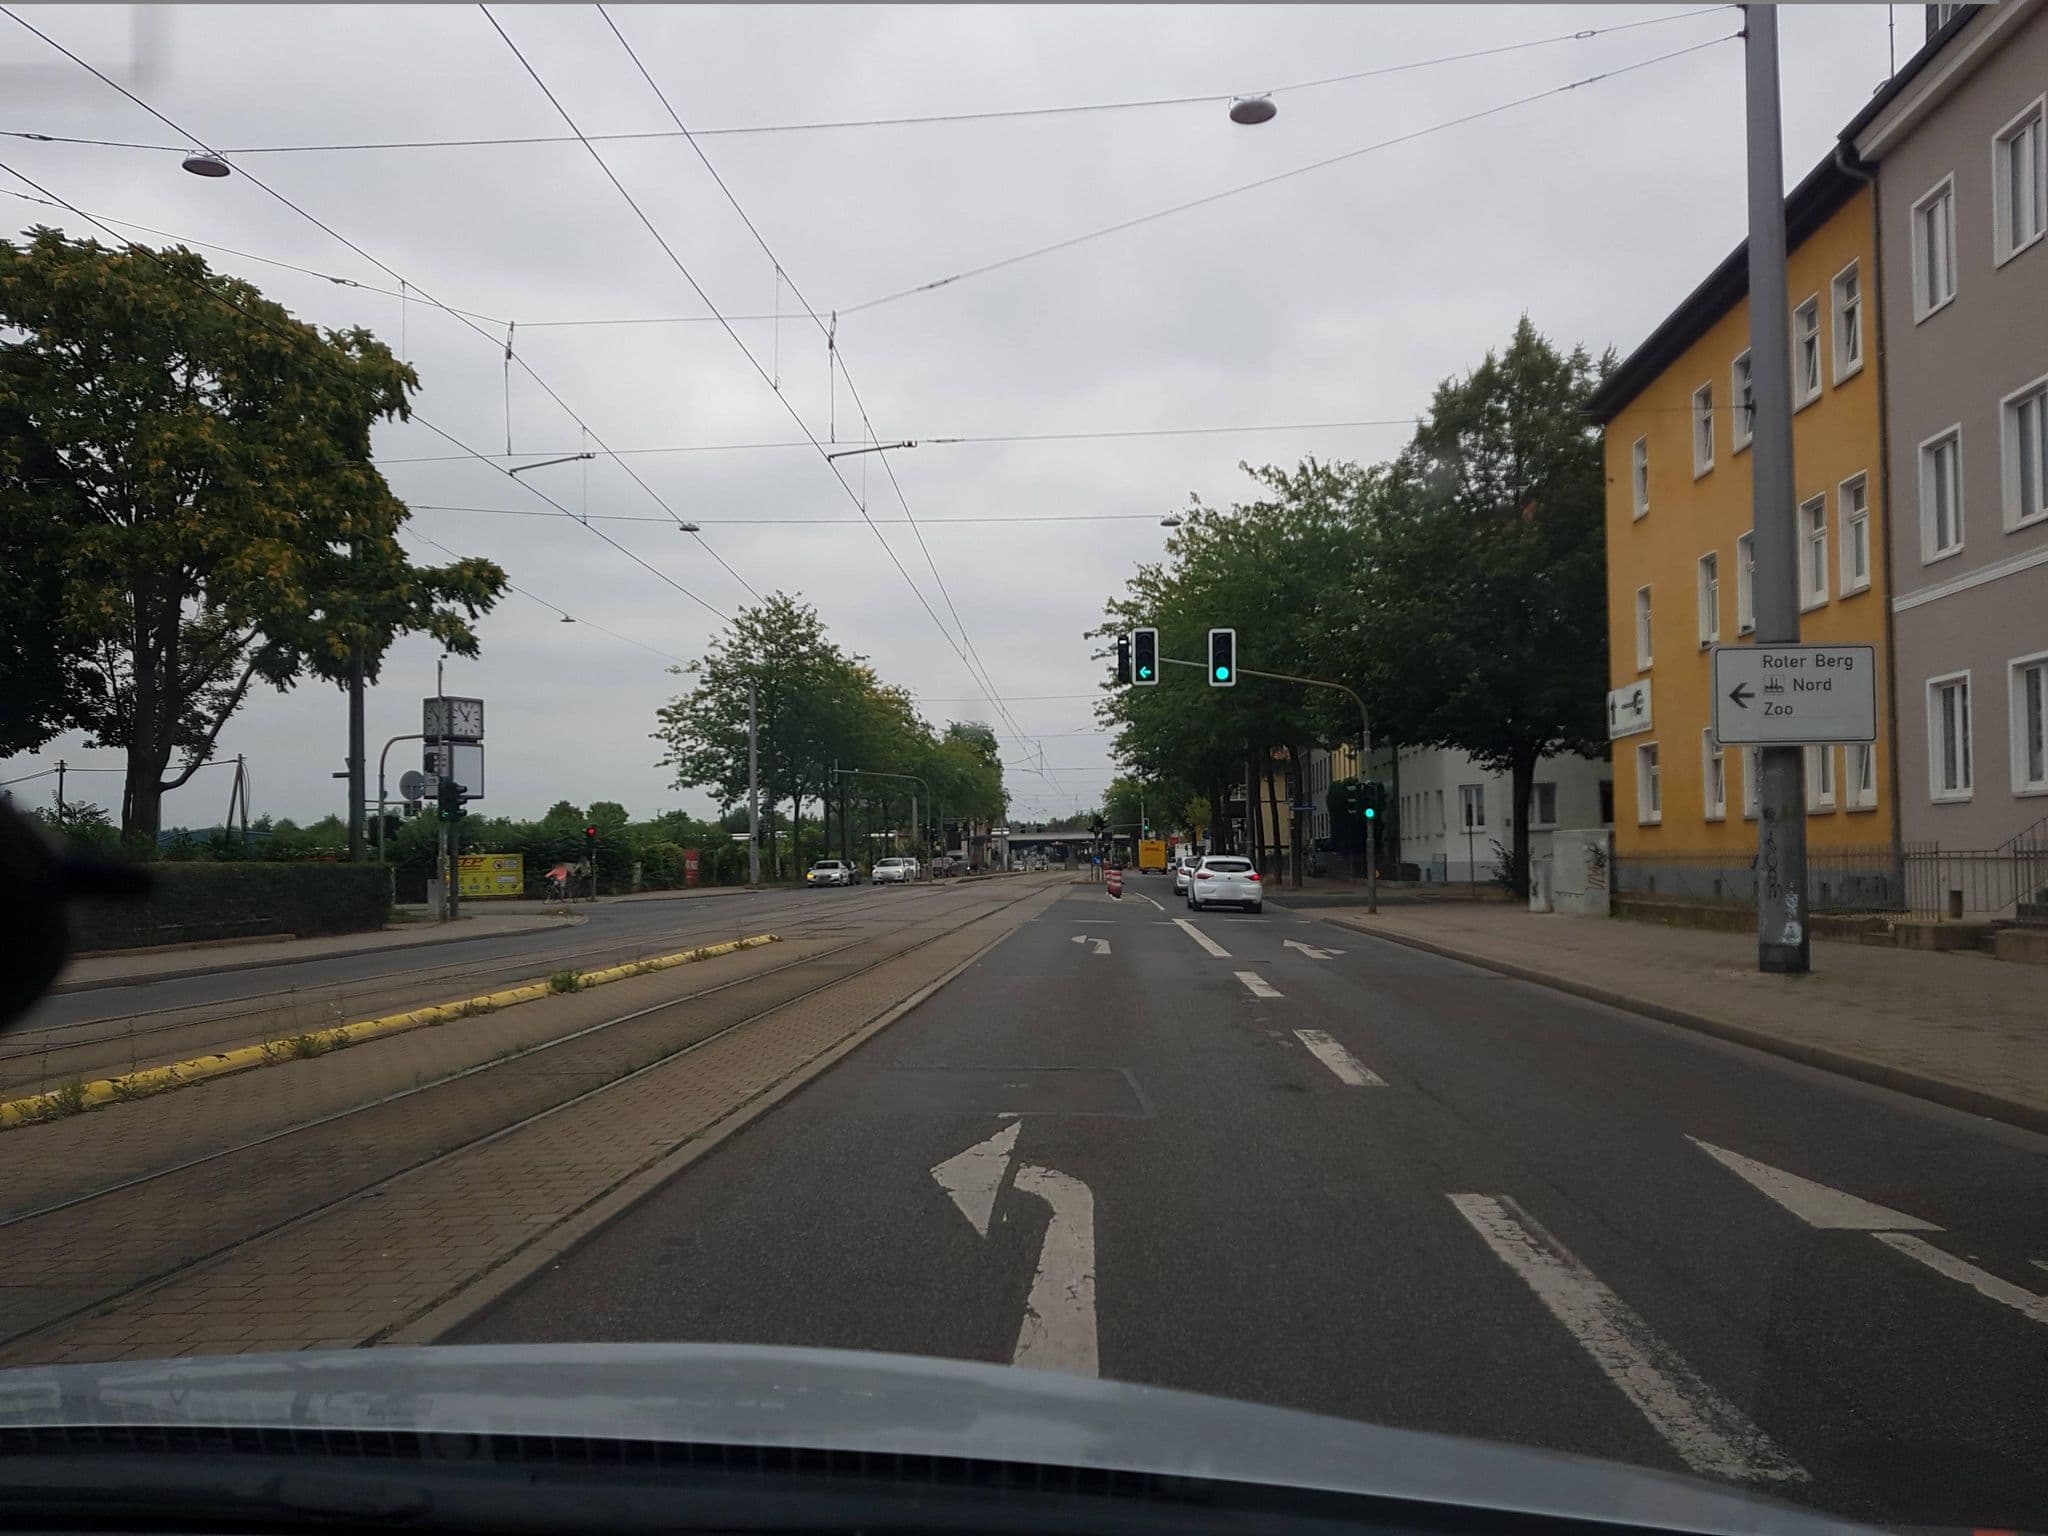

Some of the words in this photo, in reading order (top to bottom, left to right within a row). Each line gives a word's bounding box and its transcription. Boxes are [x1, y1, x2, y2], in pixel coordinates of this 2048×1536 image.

[1815, 654, 1853, 670] Berg
[1793, 678, 1832, 692] Nord
[1764, 702, 1794, 716] Zoo
